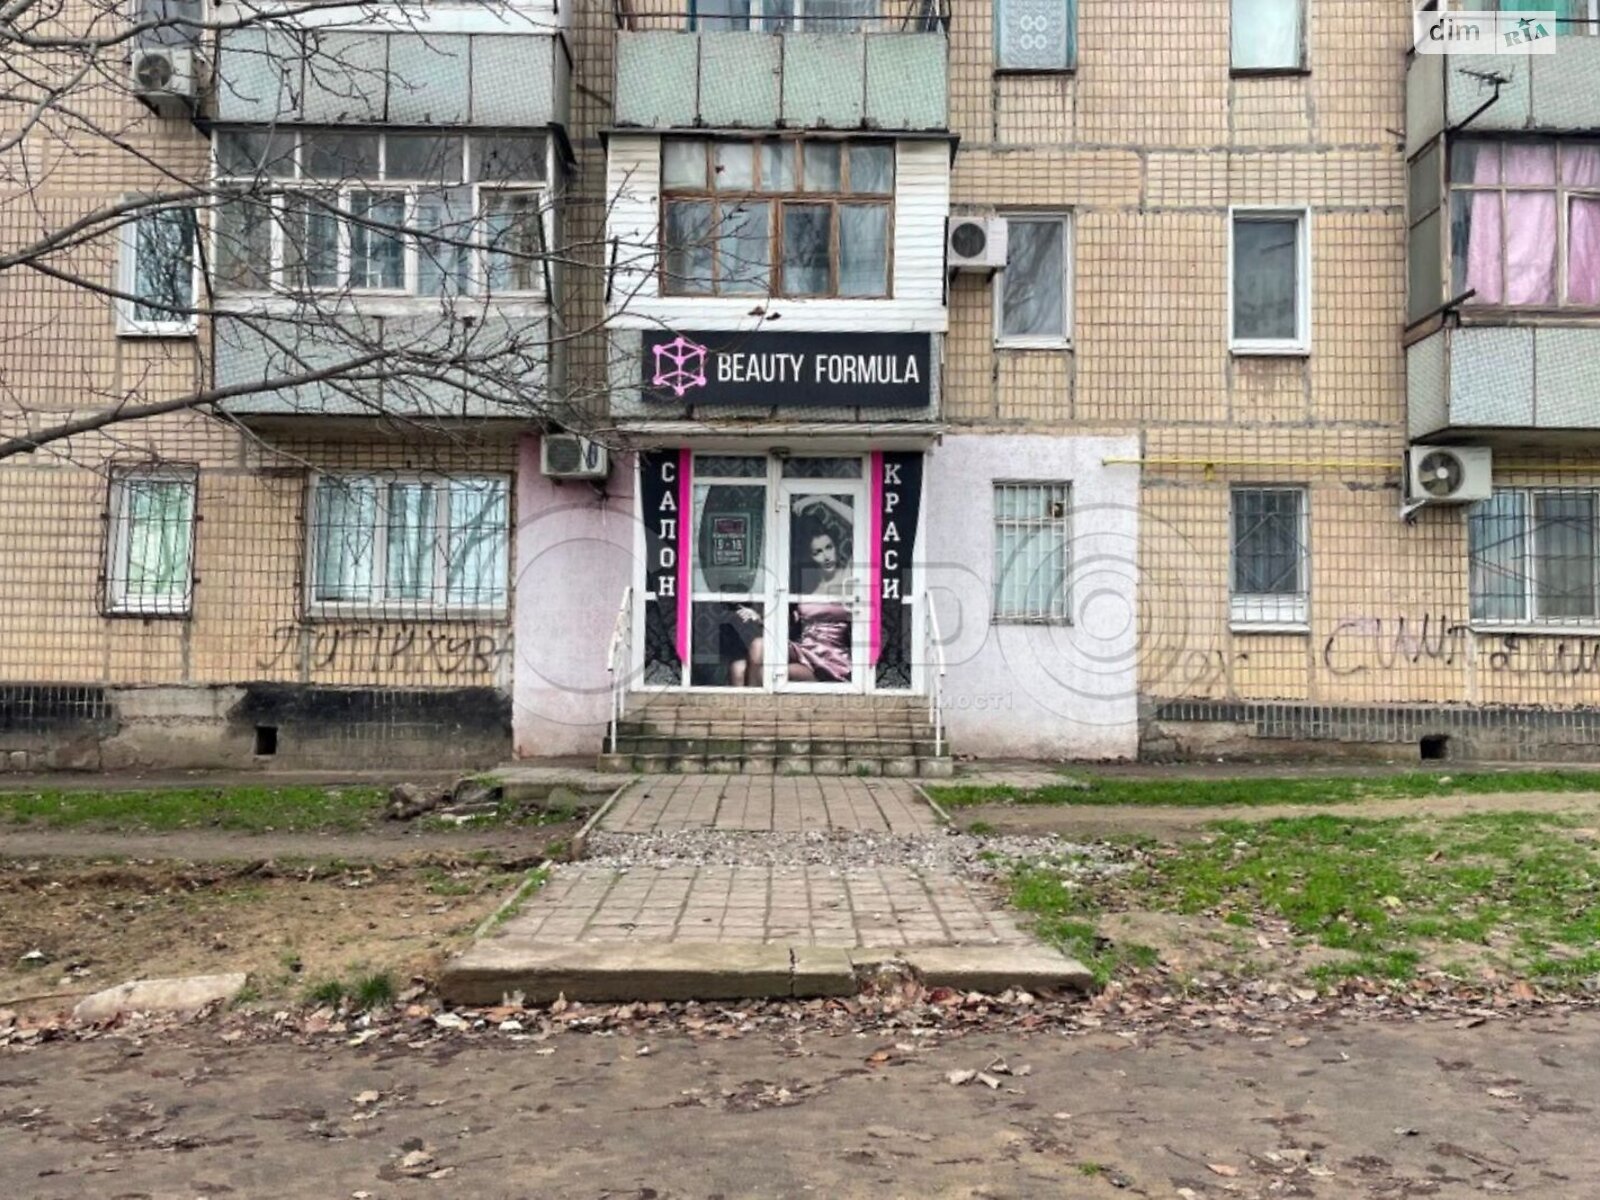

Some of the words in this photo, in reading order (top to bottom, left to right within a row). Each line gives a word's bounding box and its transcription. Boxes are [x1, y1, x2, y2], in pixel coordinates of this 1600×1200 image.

[717, 353, 804, 382] BEAUTY
[815, 355, 920, 383] FORMULA
[659, 462, 675, 597] САЛОН
[883, 463, 901, 599] КРАСИ
